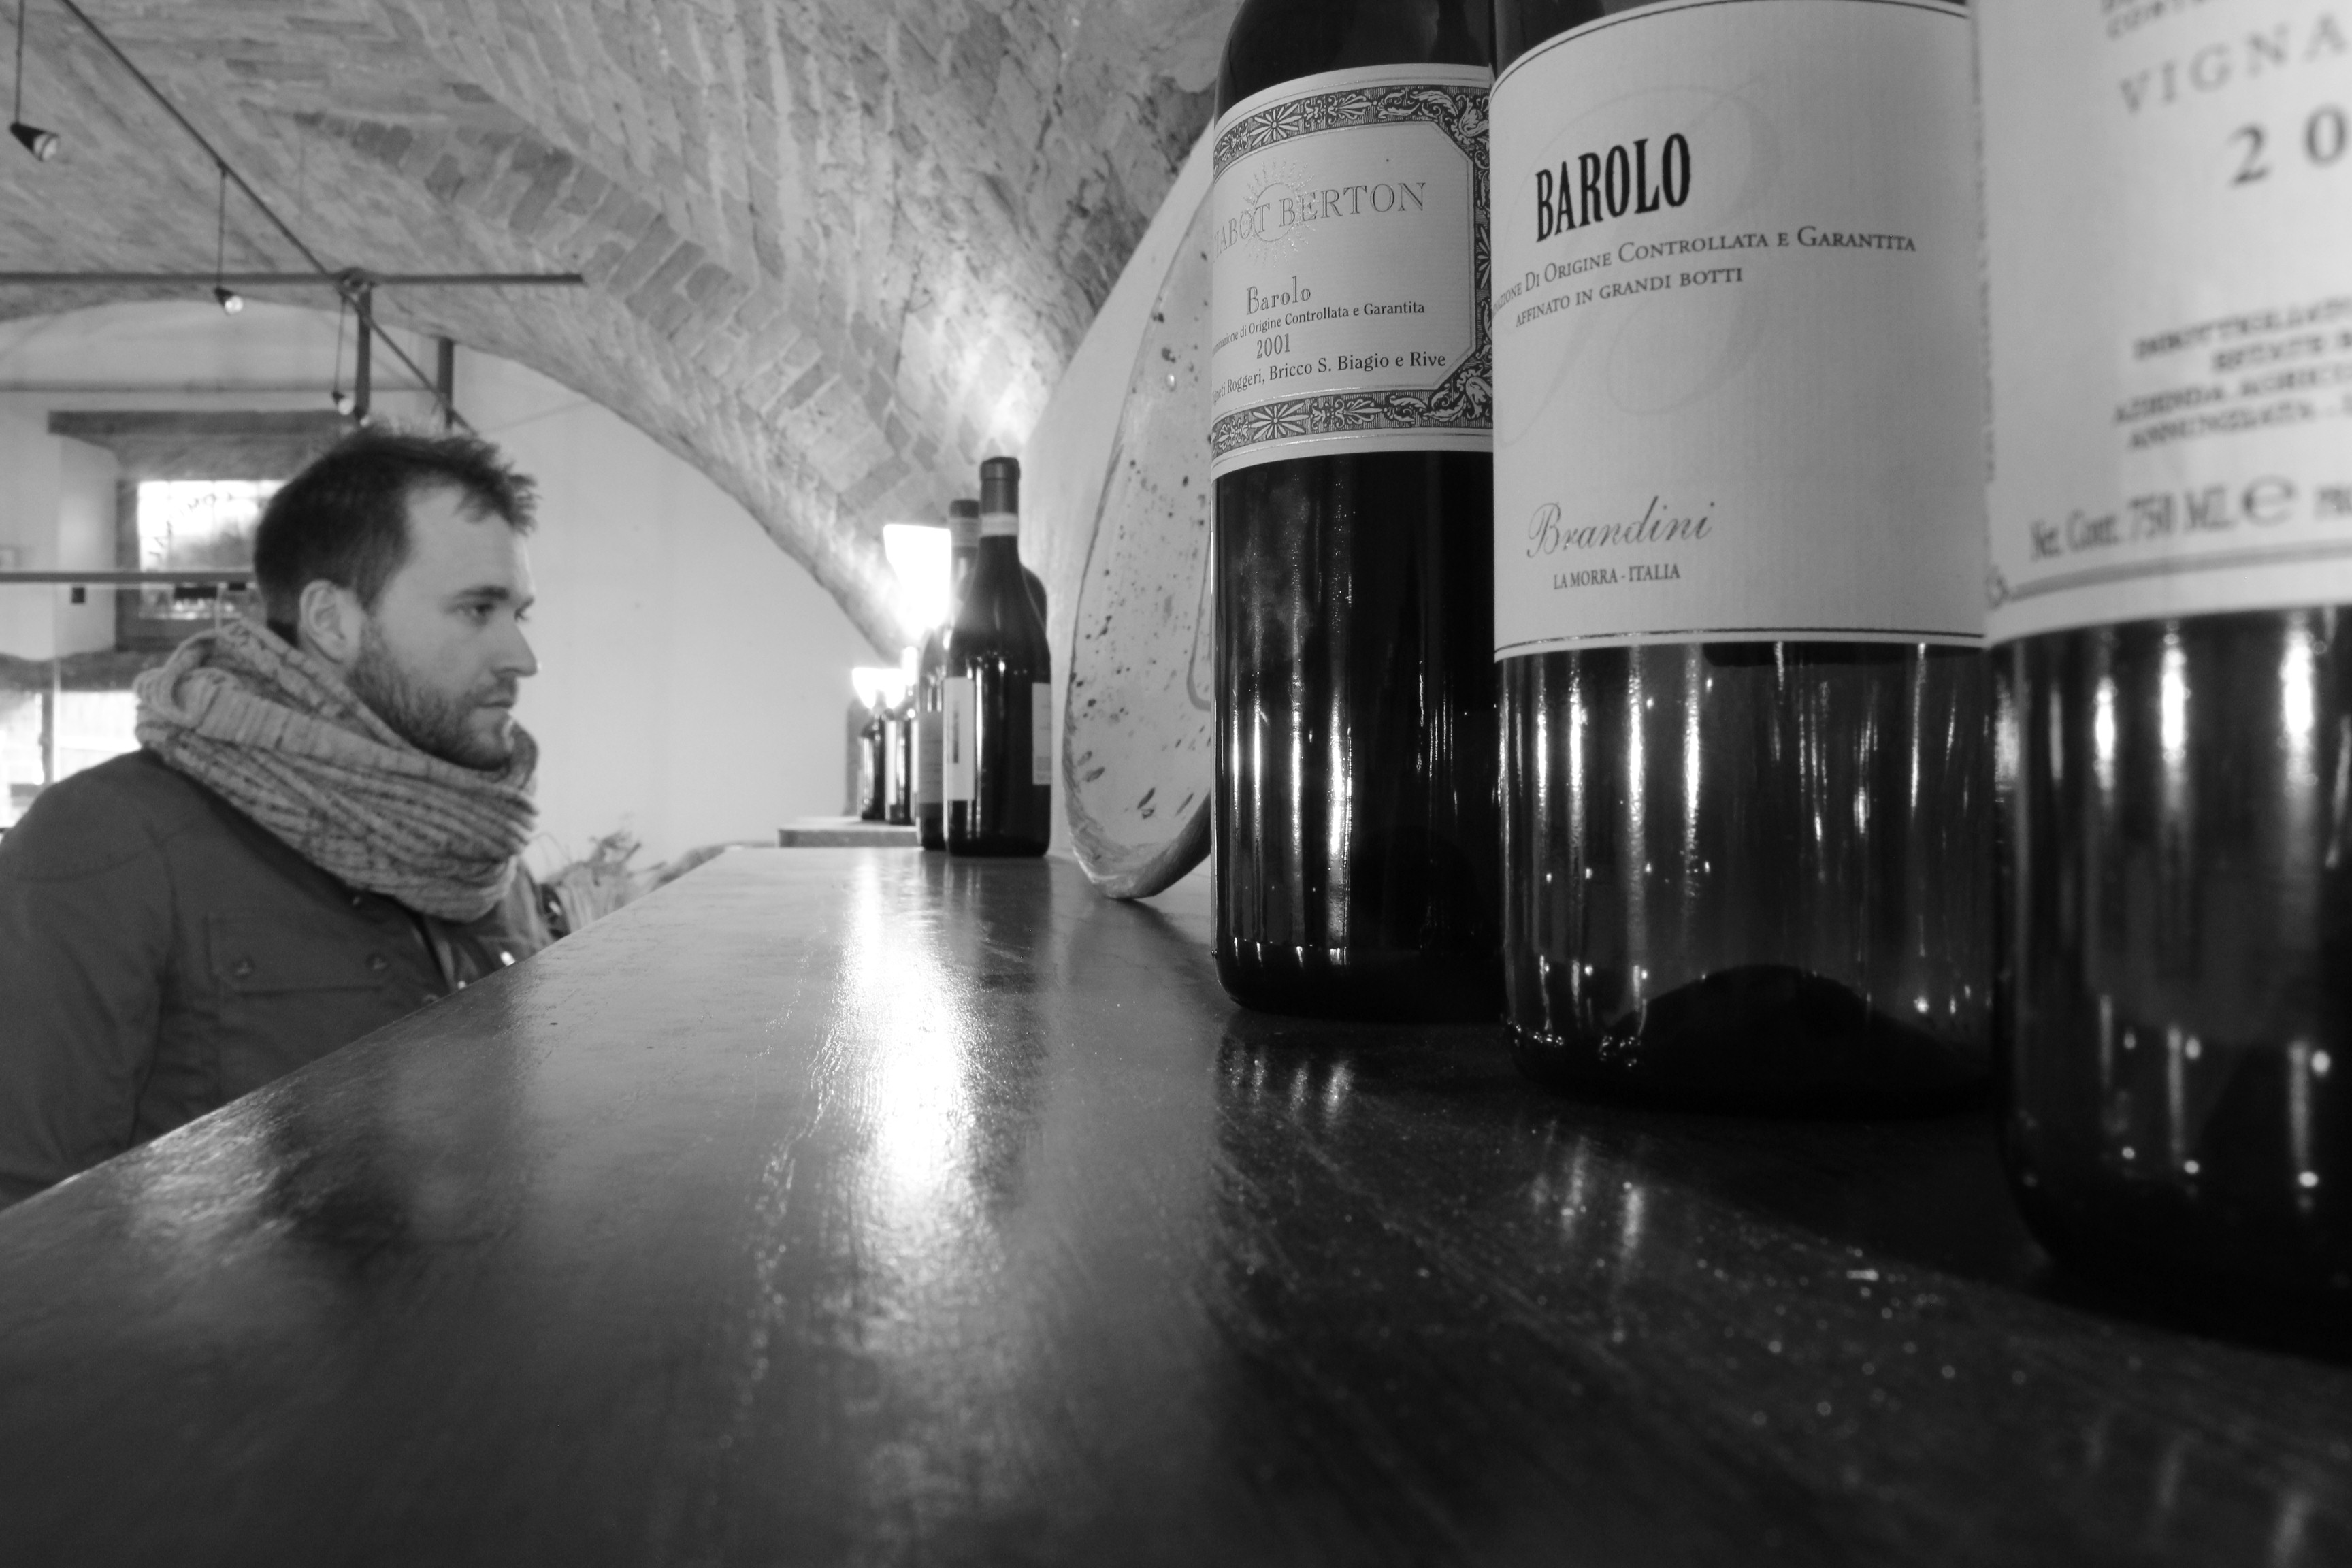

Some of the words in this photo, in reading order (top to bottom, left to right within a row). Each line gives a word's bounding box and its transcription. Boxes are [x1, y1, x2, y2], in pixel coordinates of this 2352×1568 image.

[1279, 182, 1426, 227] BERTON
[1535, 133, 1690, 243] BAROLO
[1777, 232, 1790, 247] E
[1246, 276, 1311, 315] Barolo
[1516, 295, 1570, 327] AFFINATO
[1575, 289, 1593, 306] IN
[1599, 275, 1671, 299] GRANDI
[1680, 267, 1743, 287] BOTTI
[1240, 325, 1247, 338] di
[1249, 316, 1282, 334] Origine
[1285, 306, 1349, 326] Controllata
[1353, 306, 1360, 316] e
[1364, 301, 1425, 316] Garantita
[1256, 333, 1290, 359] 2001
[1269, 363, 1313, 382] Bricco
[1318, 357, 1332, 373] S.
[1338, 353, 1389, 372] Biagio
[1395, 357, 1404, 367] e
[1410, 351, 1446, 368] Rive
[1526, 495, 1715, 557] Brandini
[1553, 574, 1567, 589] LA
[1570, 568, 1618, 587] MORRA
[1629, 564, 1681, 583] ITALIA
